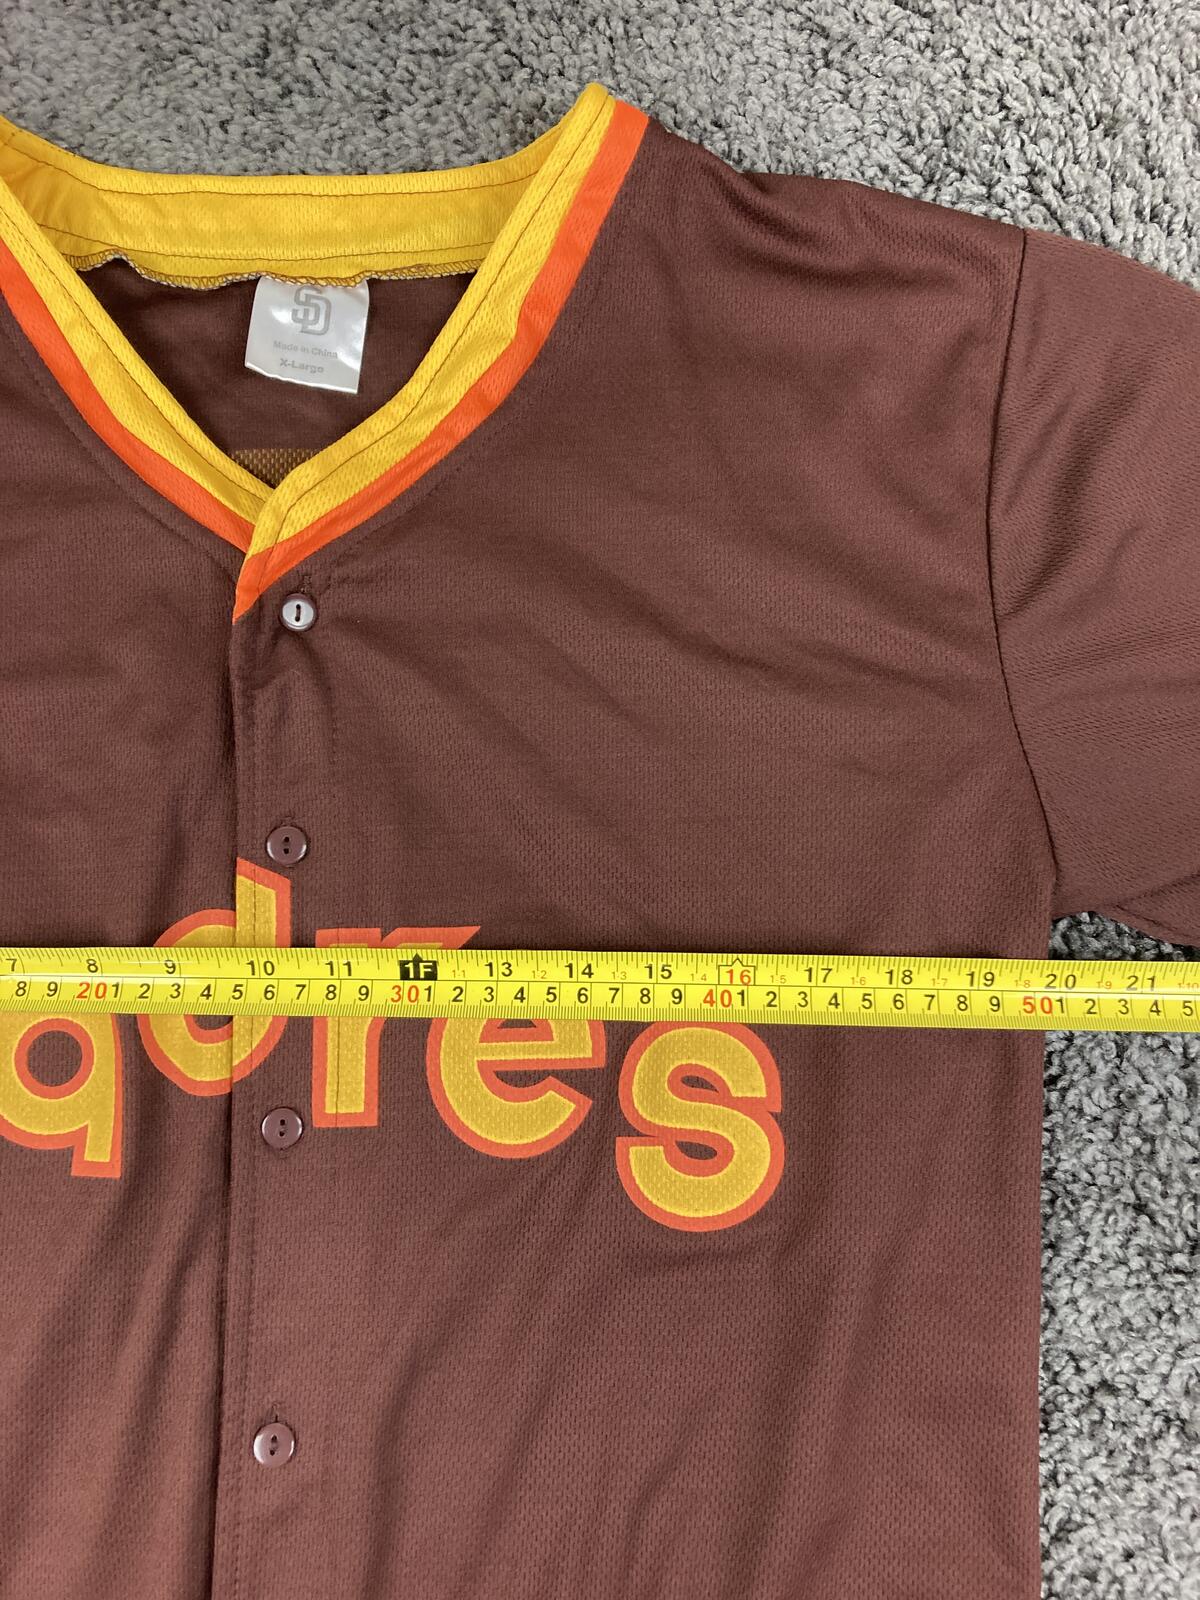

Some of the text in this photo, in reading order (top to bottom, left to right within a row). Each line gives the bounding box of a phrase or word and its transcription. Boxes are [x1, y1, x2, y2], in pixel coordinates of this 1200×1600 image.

[273, 340, 338, 359] Made in China
[280, 358, 324, 374] X-Large
[6, 958, 18, 971] 7
[87, 959, 99, 974] 8
[164, 960, 176, 975] 9
[247, 960, 275, 976] 10
[325, 961, 353, 977] 11
[403, 962, 433, 979] 1F
[484, 961, 513, 977] 13
[564, 963, 595, 979] 14
[645, 964, 672, 980] 15
[726, 969, 751, 985] 16
[804, 967, 832, 983] 17
[885, 969, 913, 985] 18
[966, 971, 995, 987] 19
[1045, 974, 1077, 990] 20
[1126, 975, 1157, 991] 21
[15, 982, 27, 997] 8
[46, 982, 59, 997] 9
[77, 982, 107, 999] 20
[138, 983, 151, 999] 2
[170, 983, 182, 999] 3
[200, 983, 213, 1000] 4
[231, 984, 244, 1000] 5
[263, 984, 276, 1000] 6
[296, 984, 307, 1000] 7
[324, 984, 337, 1001] 8
[358, 985, 370, 1001] 9
[391, 985, 419, 1003] 30
[451, 986, 464, 1002] 2
[483, 986, 495, 1002] 3
[514, 986, 526, 1003] 4
[545, 986, 557, 1003] 5
[577, 987, 589, 1003] 6
[608, 988, 620, 1004] 7
[640, 988, 651, 1004] 8
[671, 988, 683, 1005] 9
[703, 989, 732, 1008] 40
[766, 991, 778, 1008] 2
[798, 991, 809, 1008] 3
[828, 992, 840, 1009] 4
[862, 993, 873, 1009] 5
[893, 993, 904, 1010] 6
[924, 994, 935, 1010] 7
[957, 995, 968, 1011] 8
[989, 996, 1001, 1012] 9
[1023, 996, 1052, 1014] 50
[1085, 998, 1096, 1015] 2
[1118, 999, 1129, 1015] 3
[1150, 1000, 1161, 1016] 4
[1183, 1000, 1194, 1016] 5
